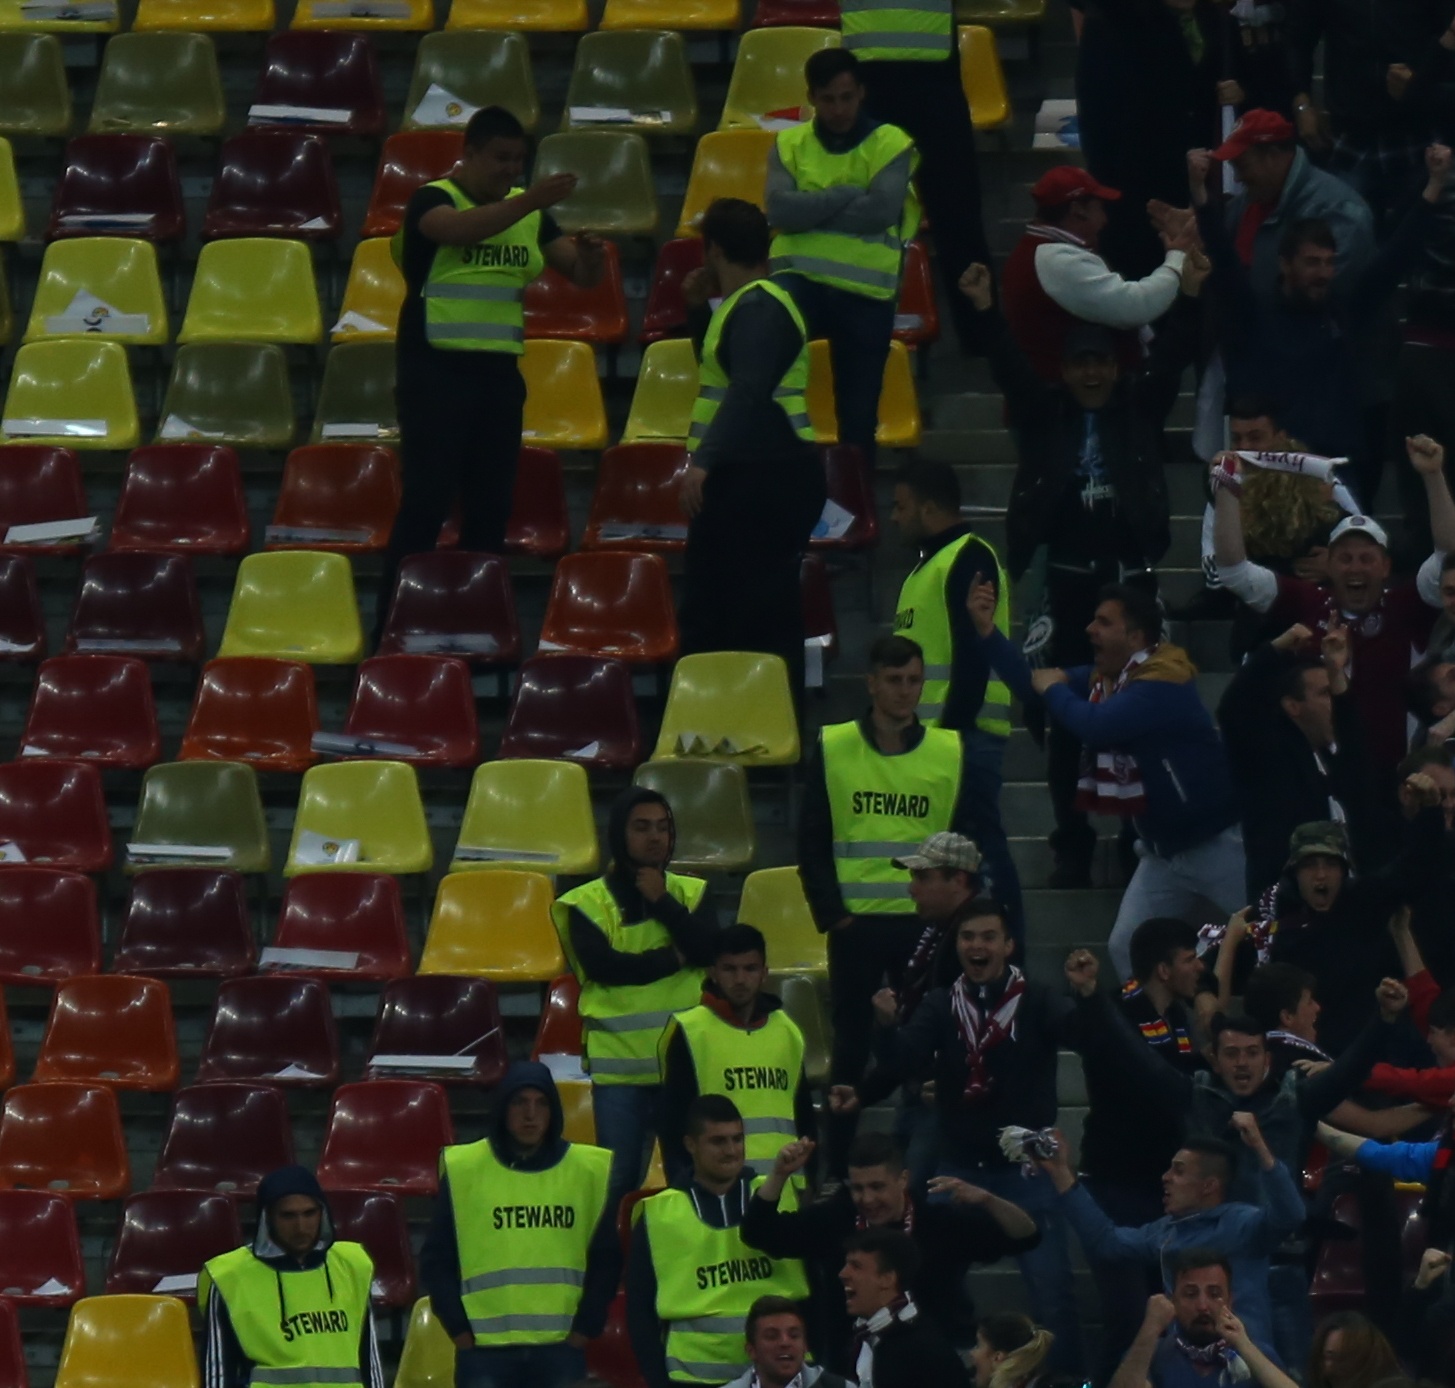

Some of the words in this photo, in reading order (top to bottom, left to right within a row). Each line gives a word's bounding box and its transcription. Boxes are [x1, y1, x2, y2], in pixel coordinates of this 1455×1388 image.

[462, 244, 529, 267] STEWARD
[853, 792, 930, 817] STEWARD
[724, 1067, 789, 1091] STEWARD
[493, 1206, 575, 1230] STEWARD
[697, 1257, 772, 1290] STEWARD
[281, 1310, 348, 1341] STEWARD
